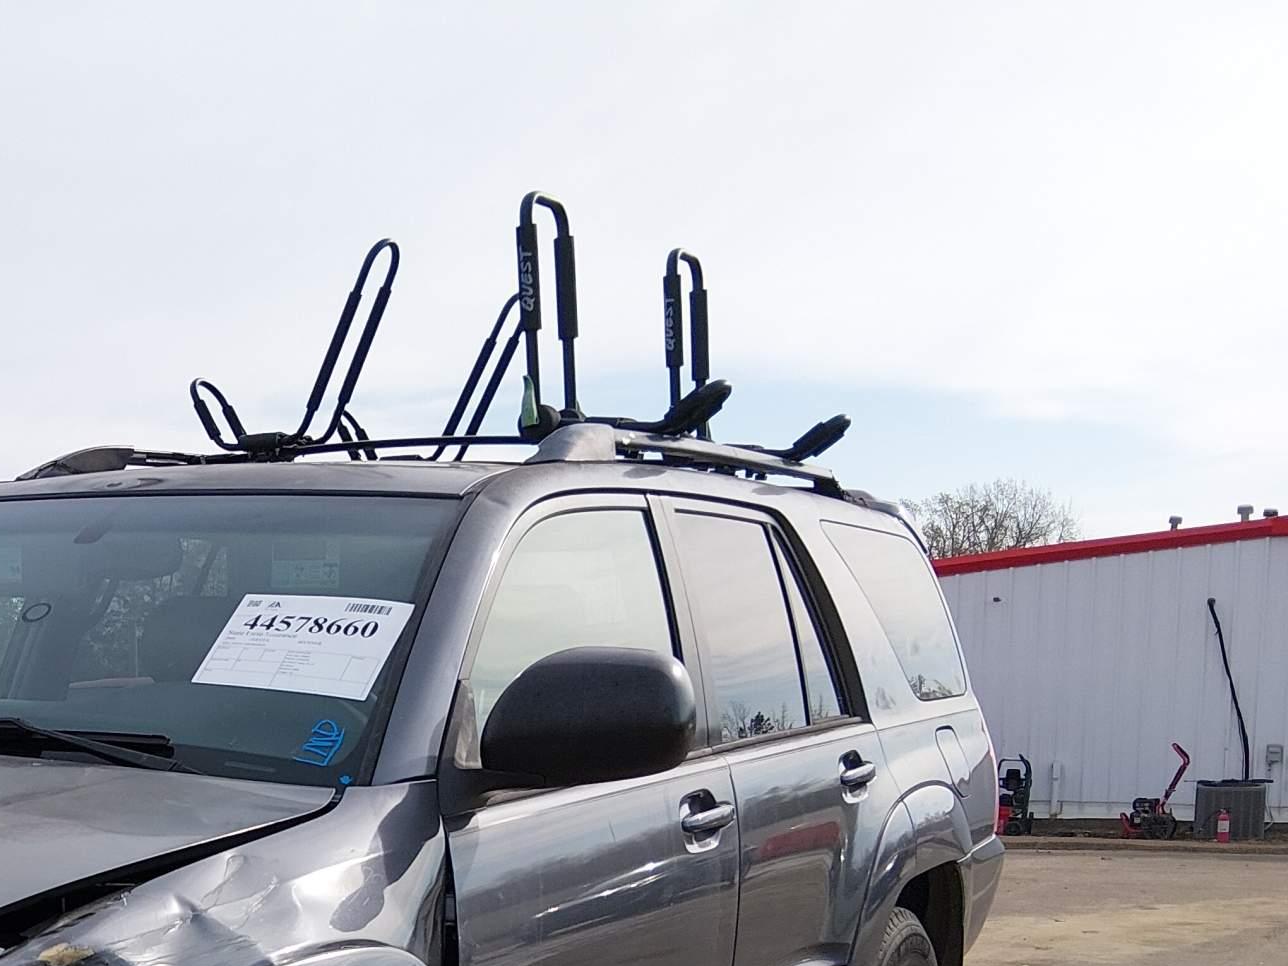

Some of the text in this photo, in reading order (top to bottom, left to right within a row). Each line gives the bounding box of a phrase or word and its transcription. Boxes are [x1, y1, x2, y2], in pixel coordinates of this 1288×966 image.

[520, 247, 534, 312] QUEST
[664, 298, 676, 351] QUEST
[243, 614, 380, 639] 44578660
